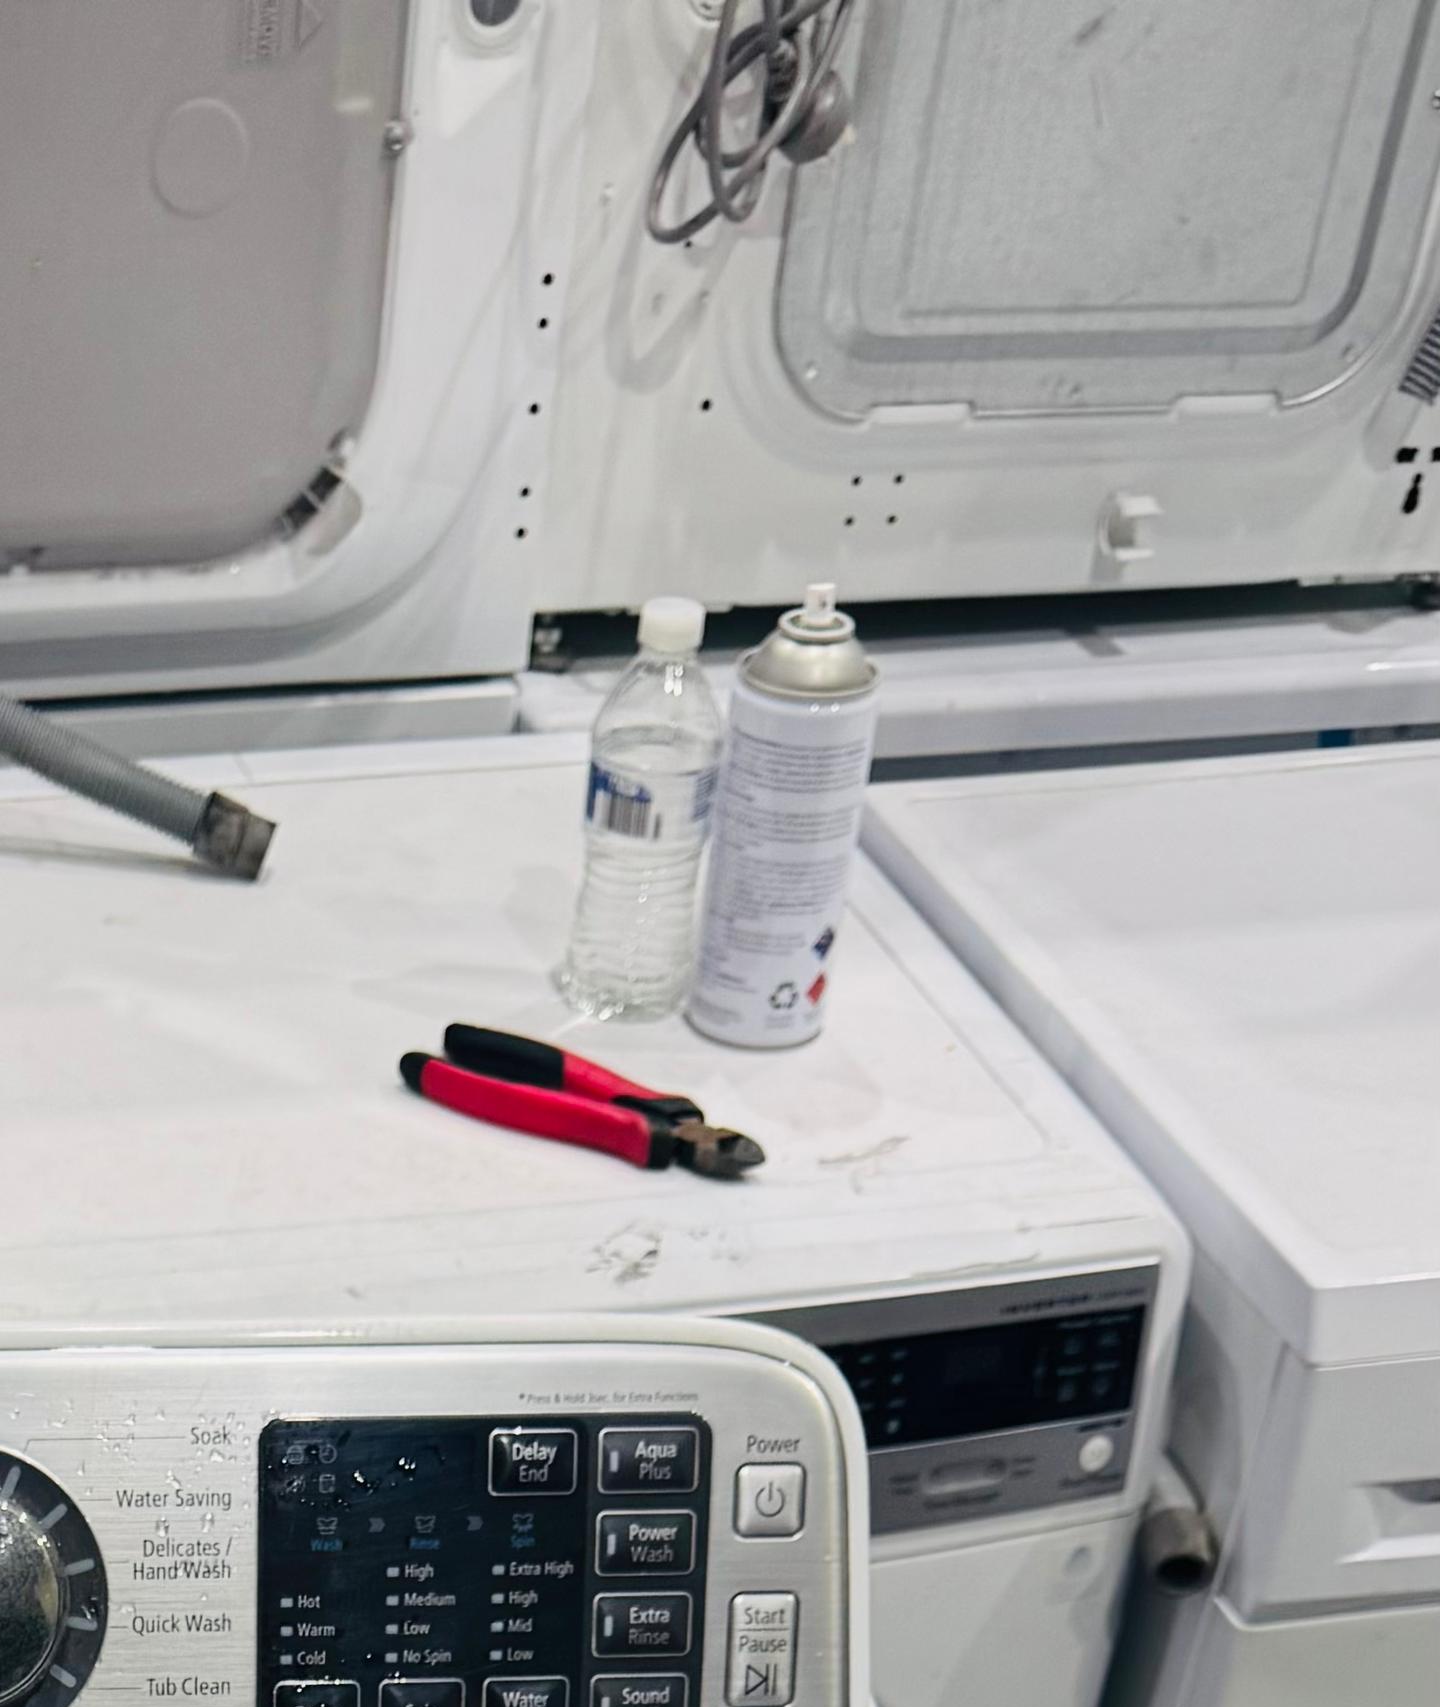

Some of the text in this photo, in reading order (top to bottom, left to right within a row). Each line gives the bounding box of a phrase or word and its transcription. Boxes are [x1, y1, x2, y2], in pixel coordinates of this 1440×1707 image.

[190, 1427, 232, 1446] Soak
[746, 1434, 801, 1454] Power
[511, 1442, 558, 1466] Delay
[634, 1441, 678, 1465] Aqua
[519, 1464, 549, 1483] End
[639, 1460, 672, 1480] Plus
[116, 1488, 232, 1511] Water Saving
[511, 1535, 536, 1549] Spin
[628, 1522, 678, 1543] Power
[143, 1538, 221, 1559] Delicates
[631, 1543, 673, 1563] Wash
[133, 1560, 232, 1581] Hand Wash
[404, 1564, 434, 1582] High
[509, 1560, 574, 1578] Extra High
[298, 1594, 321, 1610] Hot
[403, 1591, 456, 1607] Medium
[509, 1589, 538, 1607] High
[132, 1612, 232, 1636] Quick Wash
[629, 1605, 670, 1625] Extra
[744, 1606, 786, 1627] Start
[298, 1623, 336, 1638] Warm
[403, 1620, 431, 1636] Low
[507, 1617, 533, 1634] Mid
[628, 1626, 670, 1646] Rinse
[738, 1635, 787, 1655] Pause
[297, 1650, 327, 1666] Cold
[403, 1648, 453, 1667] No Spin
[507, 1646, 535, 1662] Low
[146, 1677, 232, 1696] Tub Clean
[503, 1690, 550, 1707] Water
[622, 1687, 670, 1706] Sound
